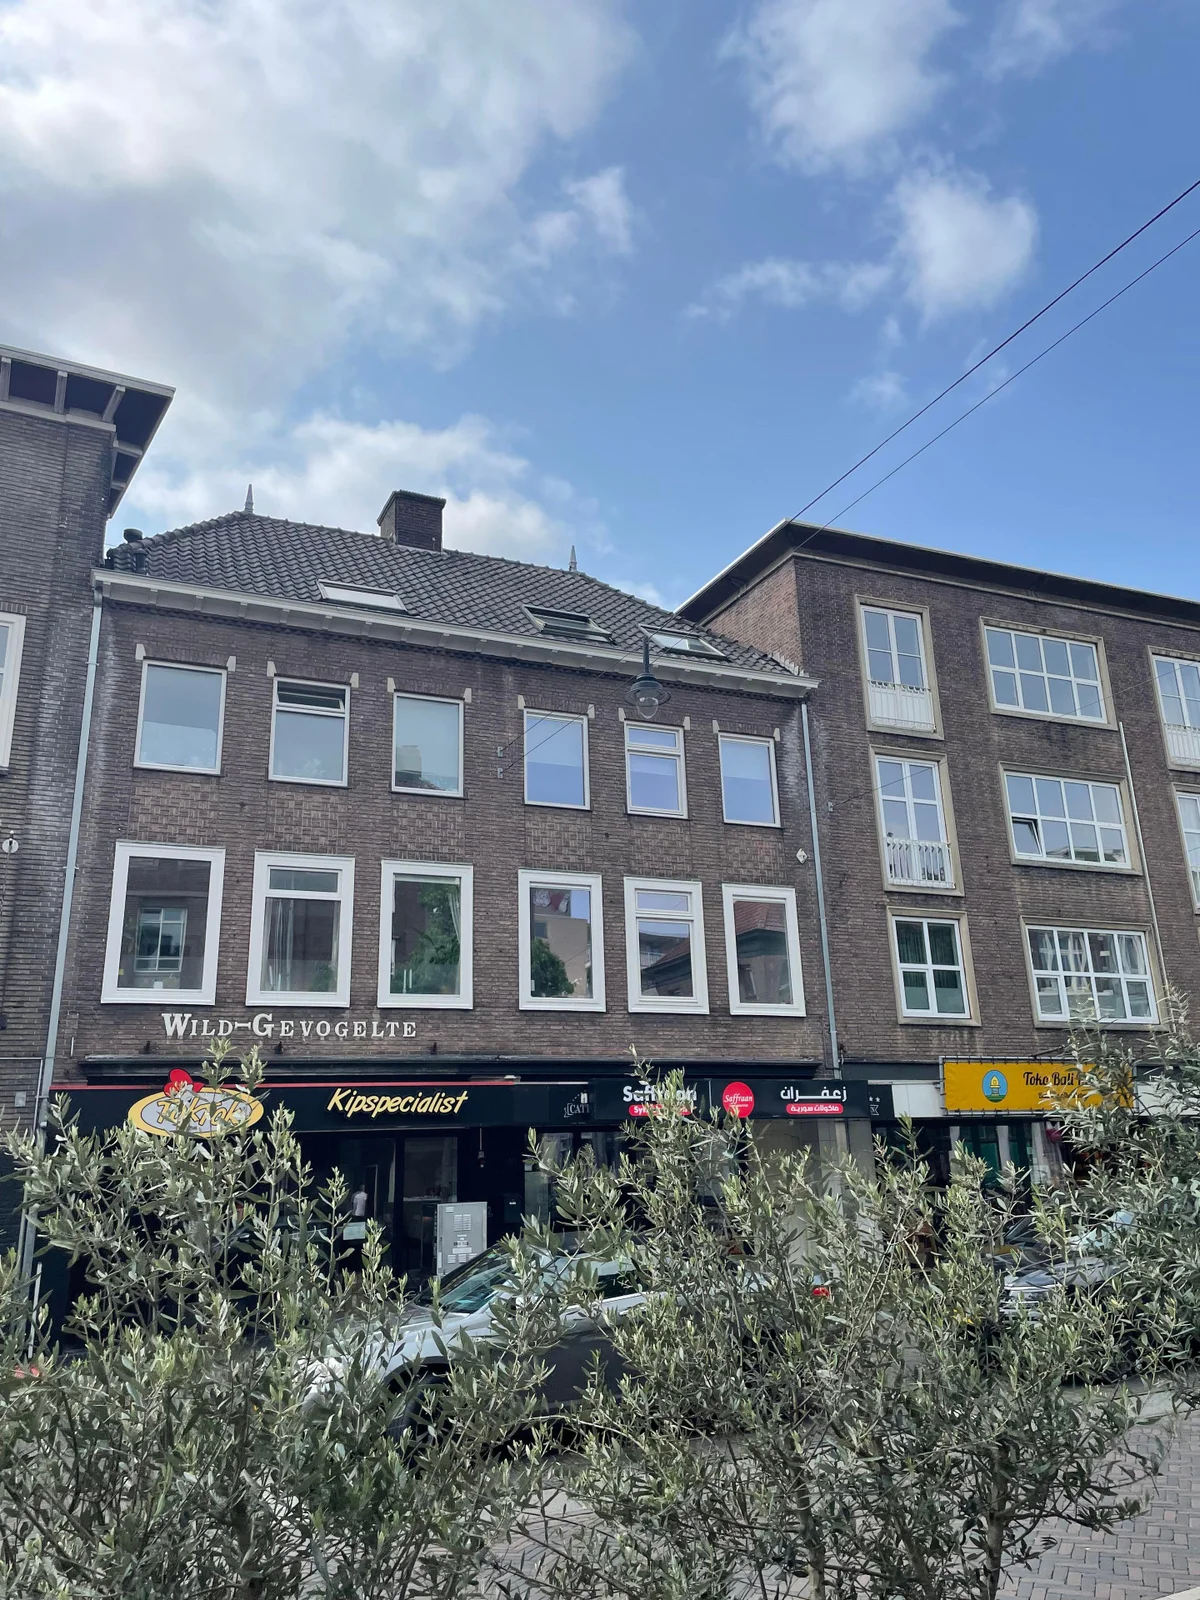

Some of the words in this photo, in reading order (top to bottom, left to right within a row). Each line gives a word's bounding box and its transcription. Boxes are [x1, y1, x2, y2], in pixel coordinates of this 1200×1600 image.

[1023, 1072, 1049, 1086] Toko
[1052, 1072, 1074, 1086] Bali
[724, 1093, 753, 1105] Saffraan
[780, 1086, 847, 1102] زعفران
[327, 1088, 468, 1118] Kipspecialist
